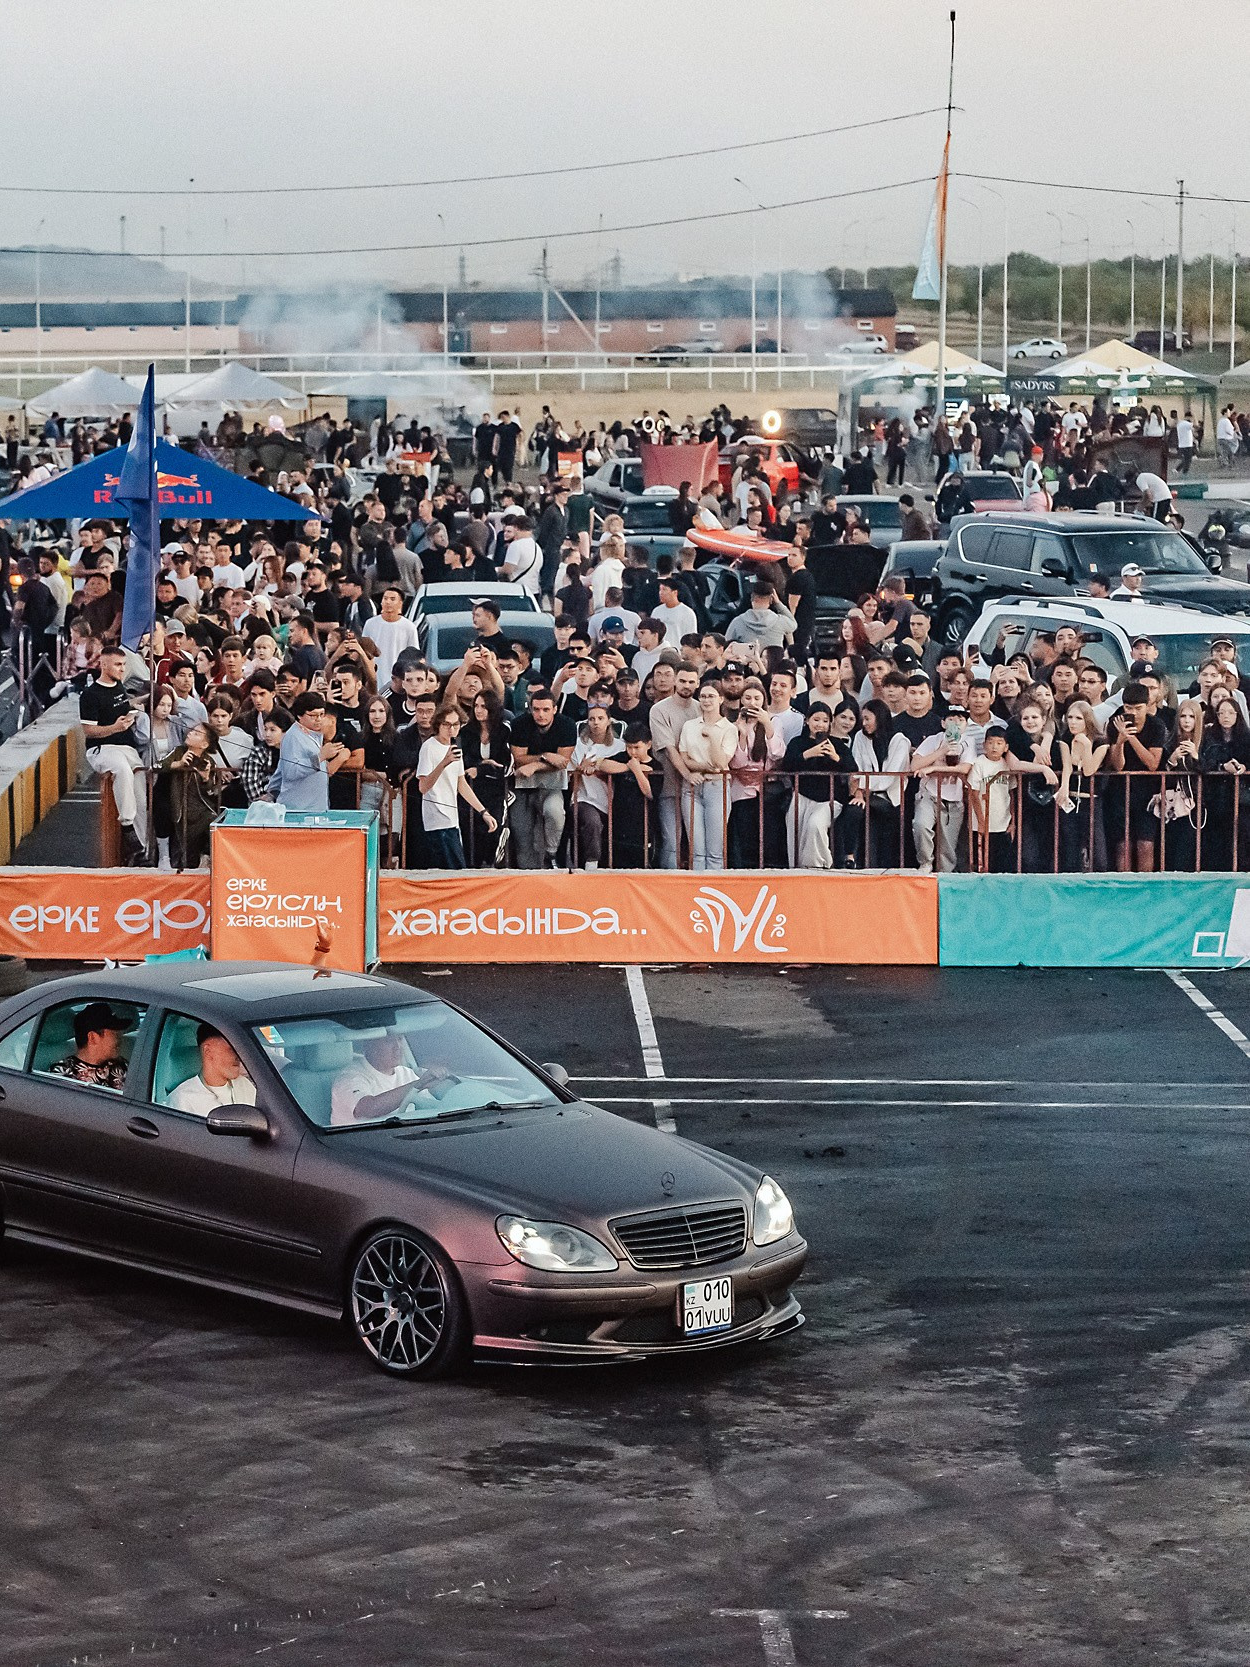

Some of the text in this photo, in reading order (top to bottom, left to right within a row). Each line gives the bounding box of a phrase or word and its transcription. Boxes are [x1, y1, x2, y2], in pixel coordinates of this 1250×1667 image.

[158, 490, 212, 504] Bull
[686, 1279, 730, 1306] KZ 010
